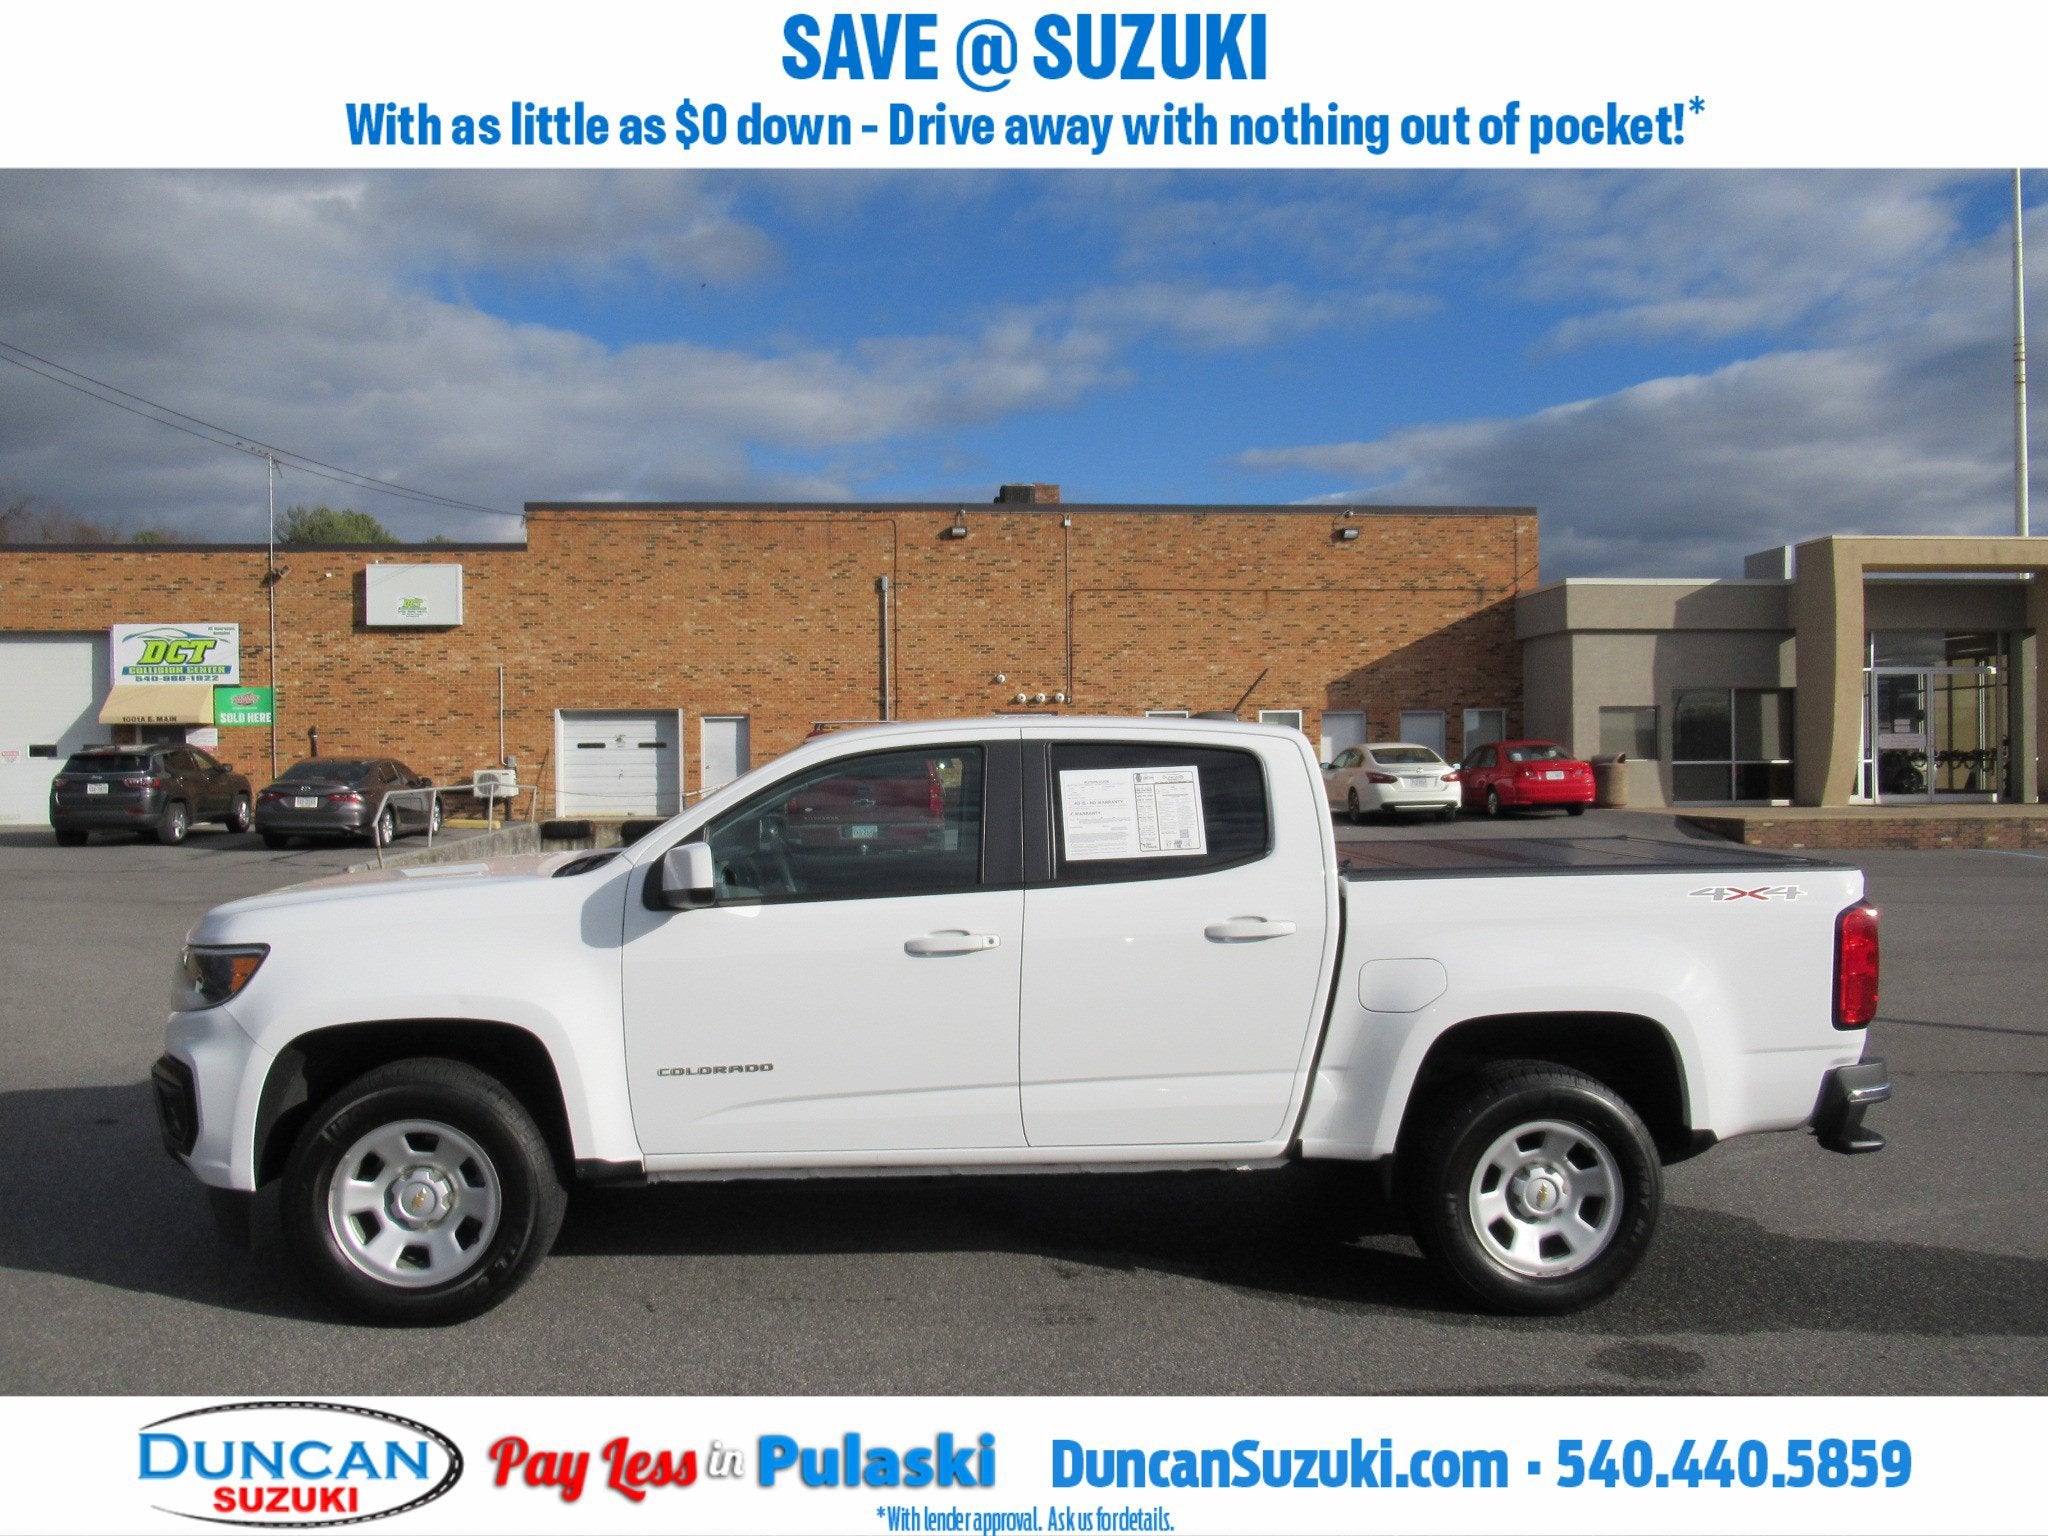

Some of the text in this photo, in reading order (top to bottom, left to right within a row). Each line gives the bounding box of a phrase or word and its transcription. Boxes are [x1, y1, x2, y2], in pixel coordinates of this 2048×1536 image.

[136, 639, 218, 665] DCT
[128, 665, 226, 675] COLLISION CENTER
[220, 712, 272, 723] SOLD HERE
[657, 1063, 774, 1076] COLORADO
